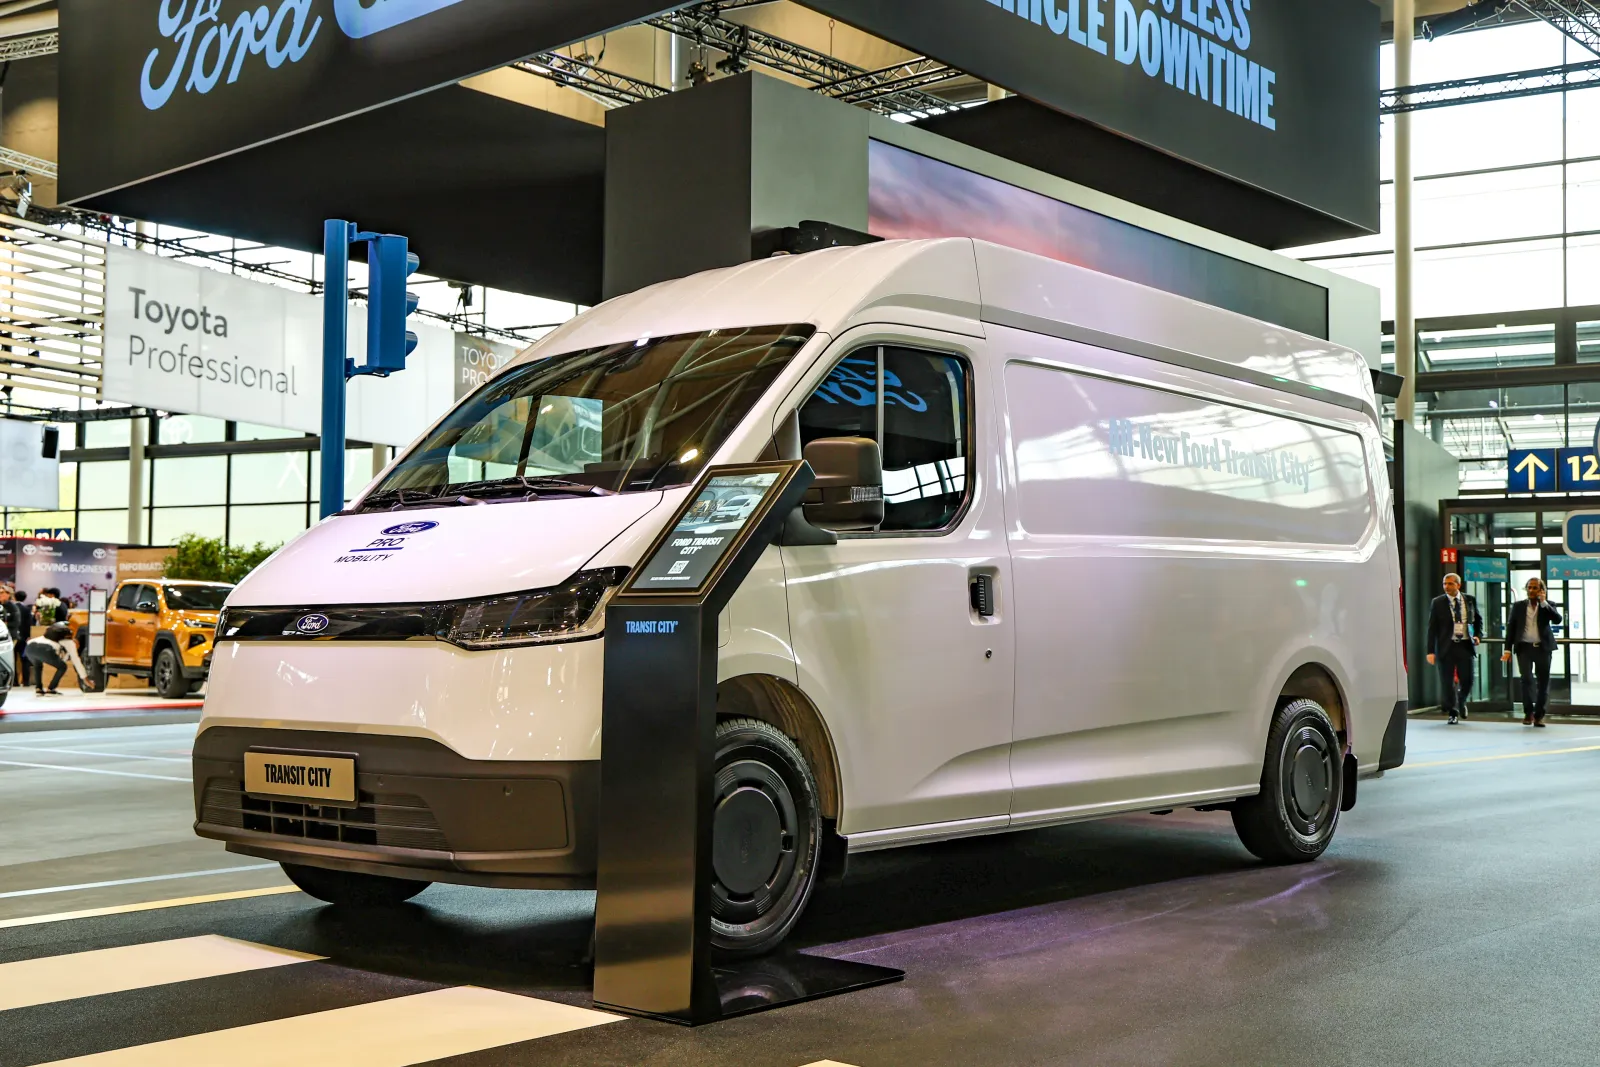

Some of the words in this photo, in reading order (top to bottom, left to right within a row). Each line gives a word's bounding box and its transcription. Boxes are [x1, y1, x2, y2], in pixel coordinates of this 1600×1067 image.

[140, 0, 323, 110] Ford
[1114, 0, 1276, 131] DOWNTIME
[128, 286, 228, 338] Toyota
[129, 334, 297, 396] Professional
[1180, 430, 1221, 472] Ford
[1222, 438, 1278, 482] Transit
[1567, 454, 1600, 482] 12
[366, 537, 406, 548] PRO
[671, 538, 693, 547] FORD
[691, 537, 725, 546] TRANSIT
[334, 553, 393, 563] MOBILITY
[32, 562, 69, 573] MOVING
[69, 563, 107, 574] BUSINESS
[119, 562, 171, 572] INFORMAT
[1572, 568, 1590, 577] Test
[299, 615, 325, 631] Ford
[626, 621, 657, 633] TRANSIT
[264, 763, 306, 786] TRANSIT
[307, 766, 332, 788] CITY
